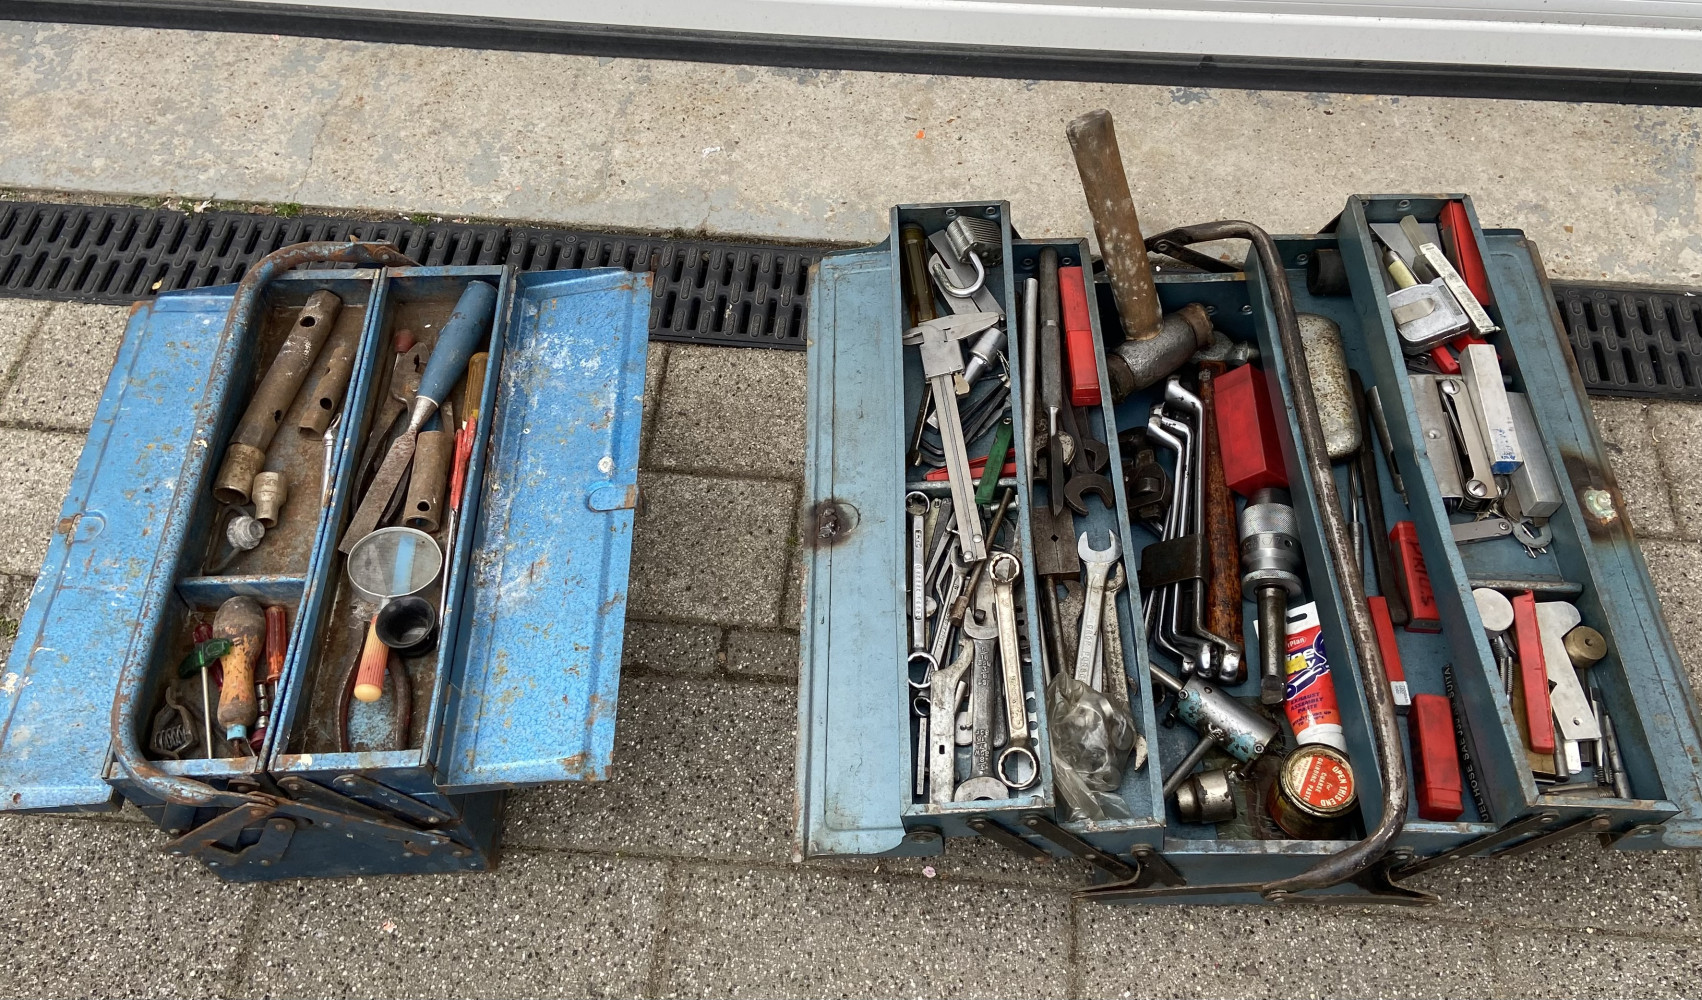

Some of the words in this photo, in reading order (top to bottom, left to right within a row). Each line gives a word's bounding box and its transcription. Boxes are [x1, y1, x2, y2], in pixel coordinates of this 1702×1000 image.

[1287, 637, 1305, 648] rPlan
[1443, 664, 1455, 699] SUITA
[1291, 692, 1320, 704] EXHAUST
[1291, 697, 1323, 711] ASSEMBLY
[1459, 738, 1470, 760] SAE
[1310, 757, 1324, 783] GRINDING
[1332, 766, 1347, 784] OPEN
[1315, 772, 1327, 793] COARSE
[1467, 765, 1480, 797] HOSE
[1302, 784, 1314, 801] PASTE
[1334, 785, 1348, 802] THIS
[1320, 798, 1337, 807] END
[1476, 798, 1489, 822] UEL
